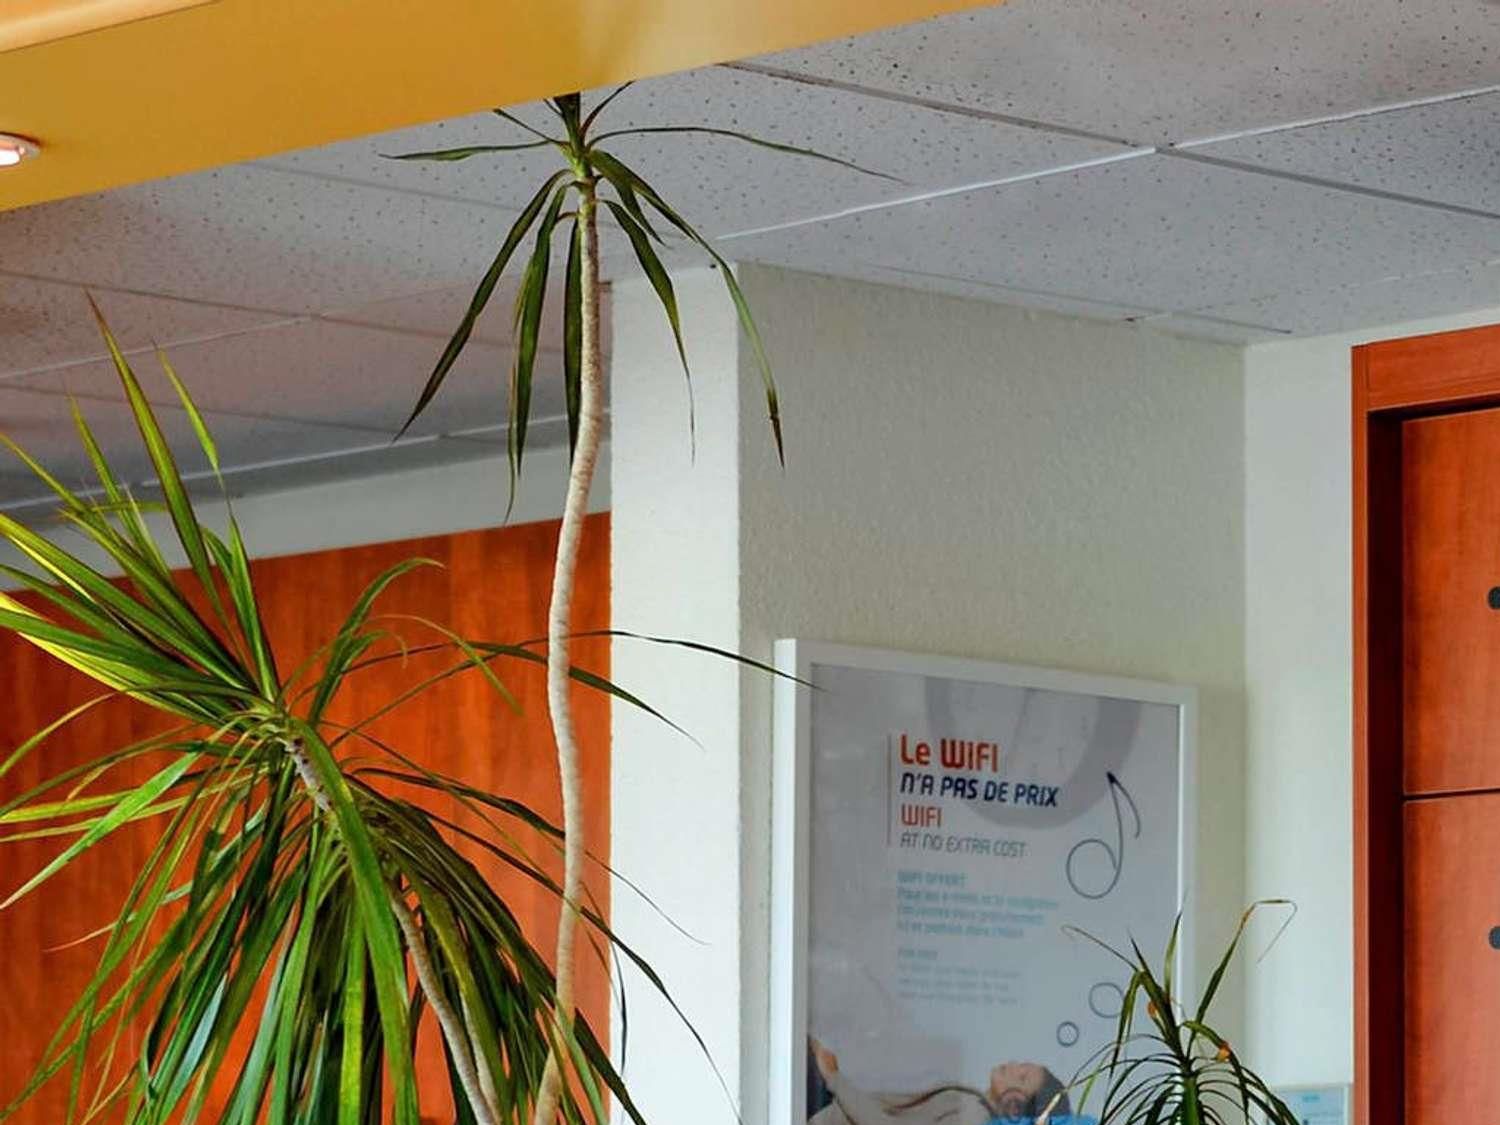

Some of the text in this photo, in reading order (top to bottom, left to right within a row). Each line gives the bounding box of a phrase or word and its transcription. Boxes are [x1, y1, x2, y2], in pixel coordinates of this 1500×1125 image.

[901, 734, 998, 772] Le WIFI
[940, 776, 978, 799] PAS
[984, 781, 1009, 802] DE
[1014, 783, 1059, 807] PRIX
[901, 804, 941, 828] WIFI
[900, 831, 1026, 857] AT NO EXTRA COST
